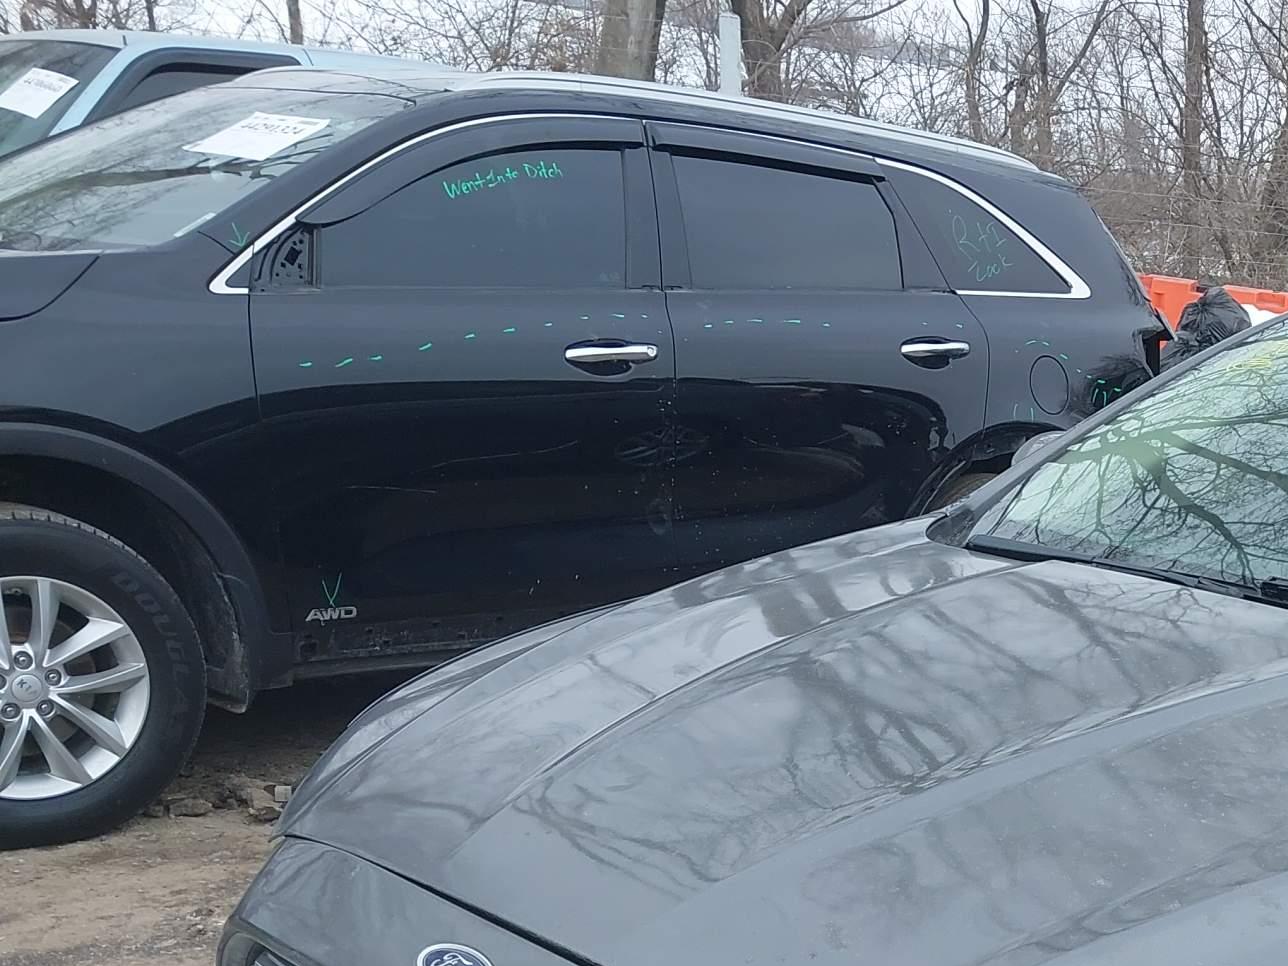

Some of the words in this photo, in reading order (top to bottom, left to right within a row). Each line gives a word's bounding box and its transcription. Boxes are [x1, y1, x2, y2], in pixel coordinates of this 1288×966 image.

[443, 172, 485, 199] Went
[522, 161, 563, 179] Ditch
[305, 606, 357, 622] AWD
